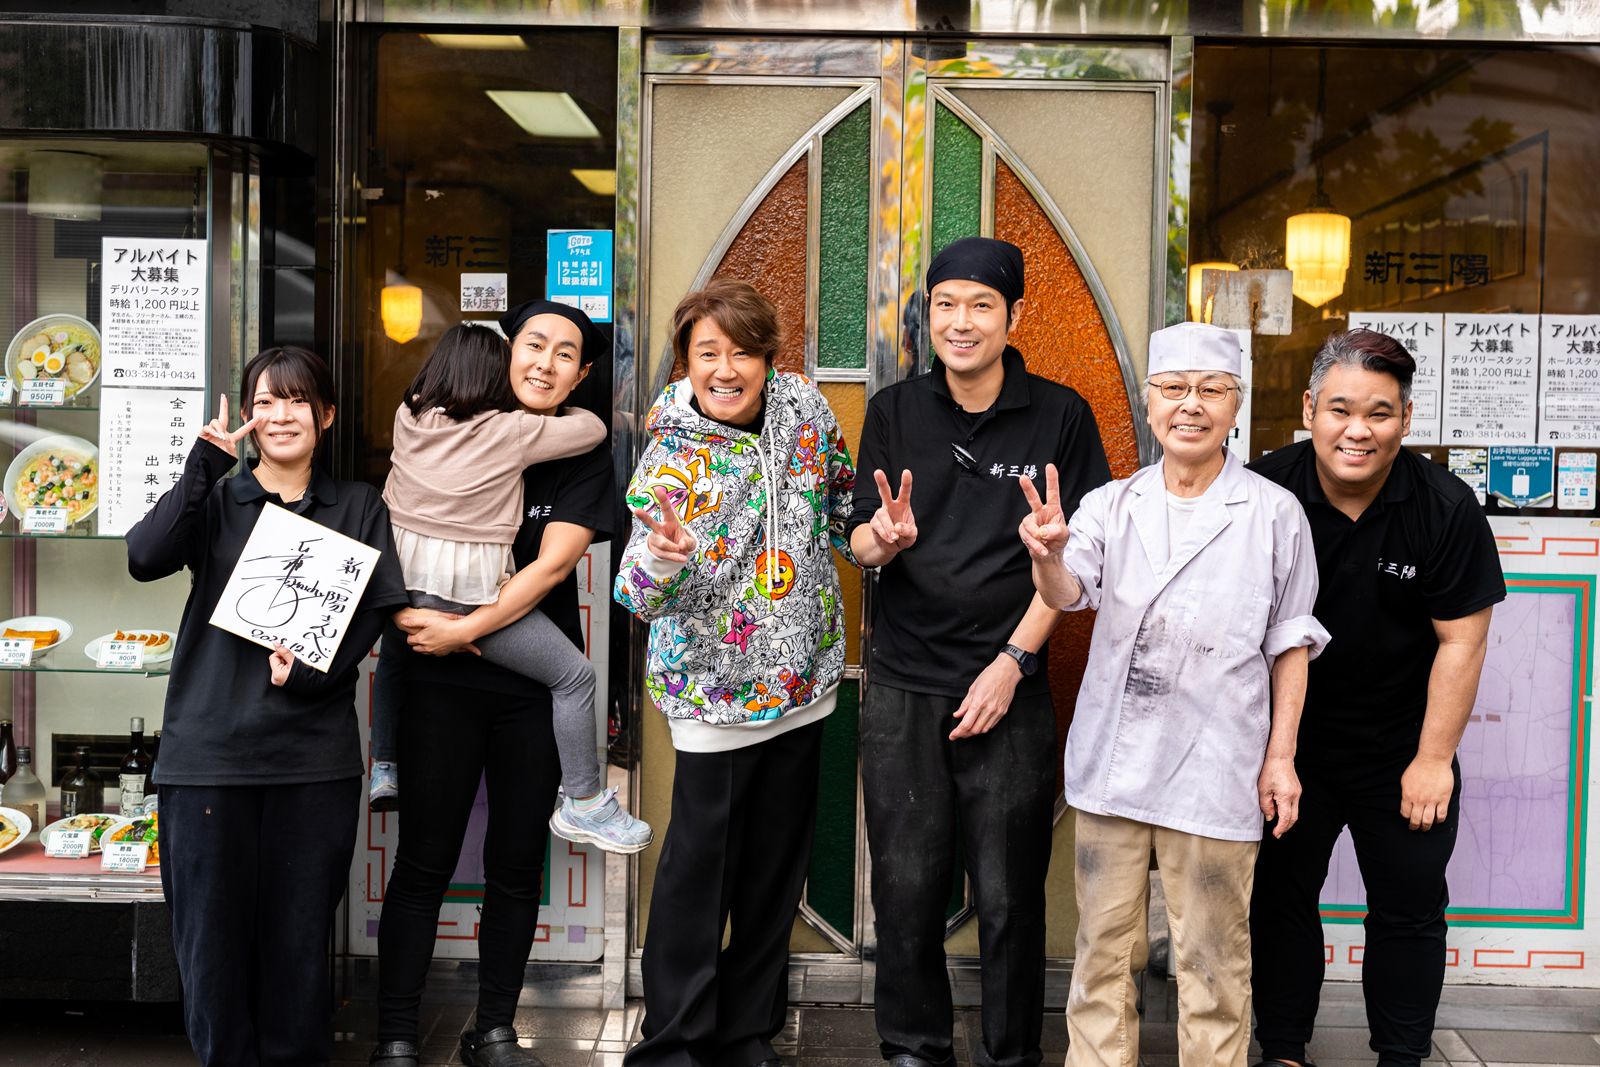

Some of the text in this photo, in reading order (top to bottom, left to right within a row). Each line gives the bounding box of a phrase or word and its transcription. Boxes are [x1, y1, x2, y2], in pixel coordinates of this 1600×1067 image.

[113, 248, 198, 265] アルバイト
[131, 266, 179, 282] 大募集
[562, 268, 598, 277] クーポン
[1363, 251, 1489, 286] 新三陽
[110, 285, 199, 296] デリバリースタッフ
[462, 286, 496, 297] ご宴会
[110, 299, 200, 311] 時給 1,200 円以上
[1455, 323, 1531, 338] アルバイト
[1551, 324, 1600, 338] アルバ
[1470, 338, 1514, 353] 大募集
[1451, 355, 1532, 365] デリバリースタッフ
[124, 369, 197, 380] 03-3814-0434
[1451, 367, 1532, 378] 時給 1,200 円以上
[1547, 369, 1599, 379] 時給 1,200
[1462, 430, 1527, 439] 03-3814-0434
[989, 463, 1038, 480] 新三陽
